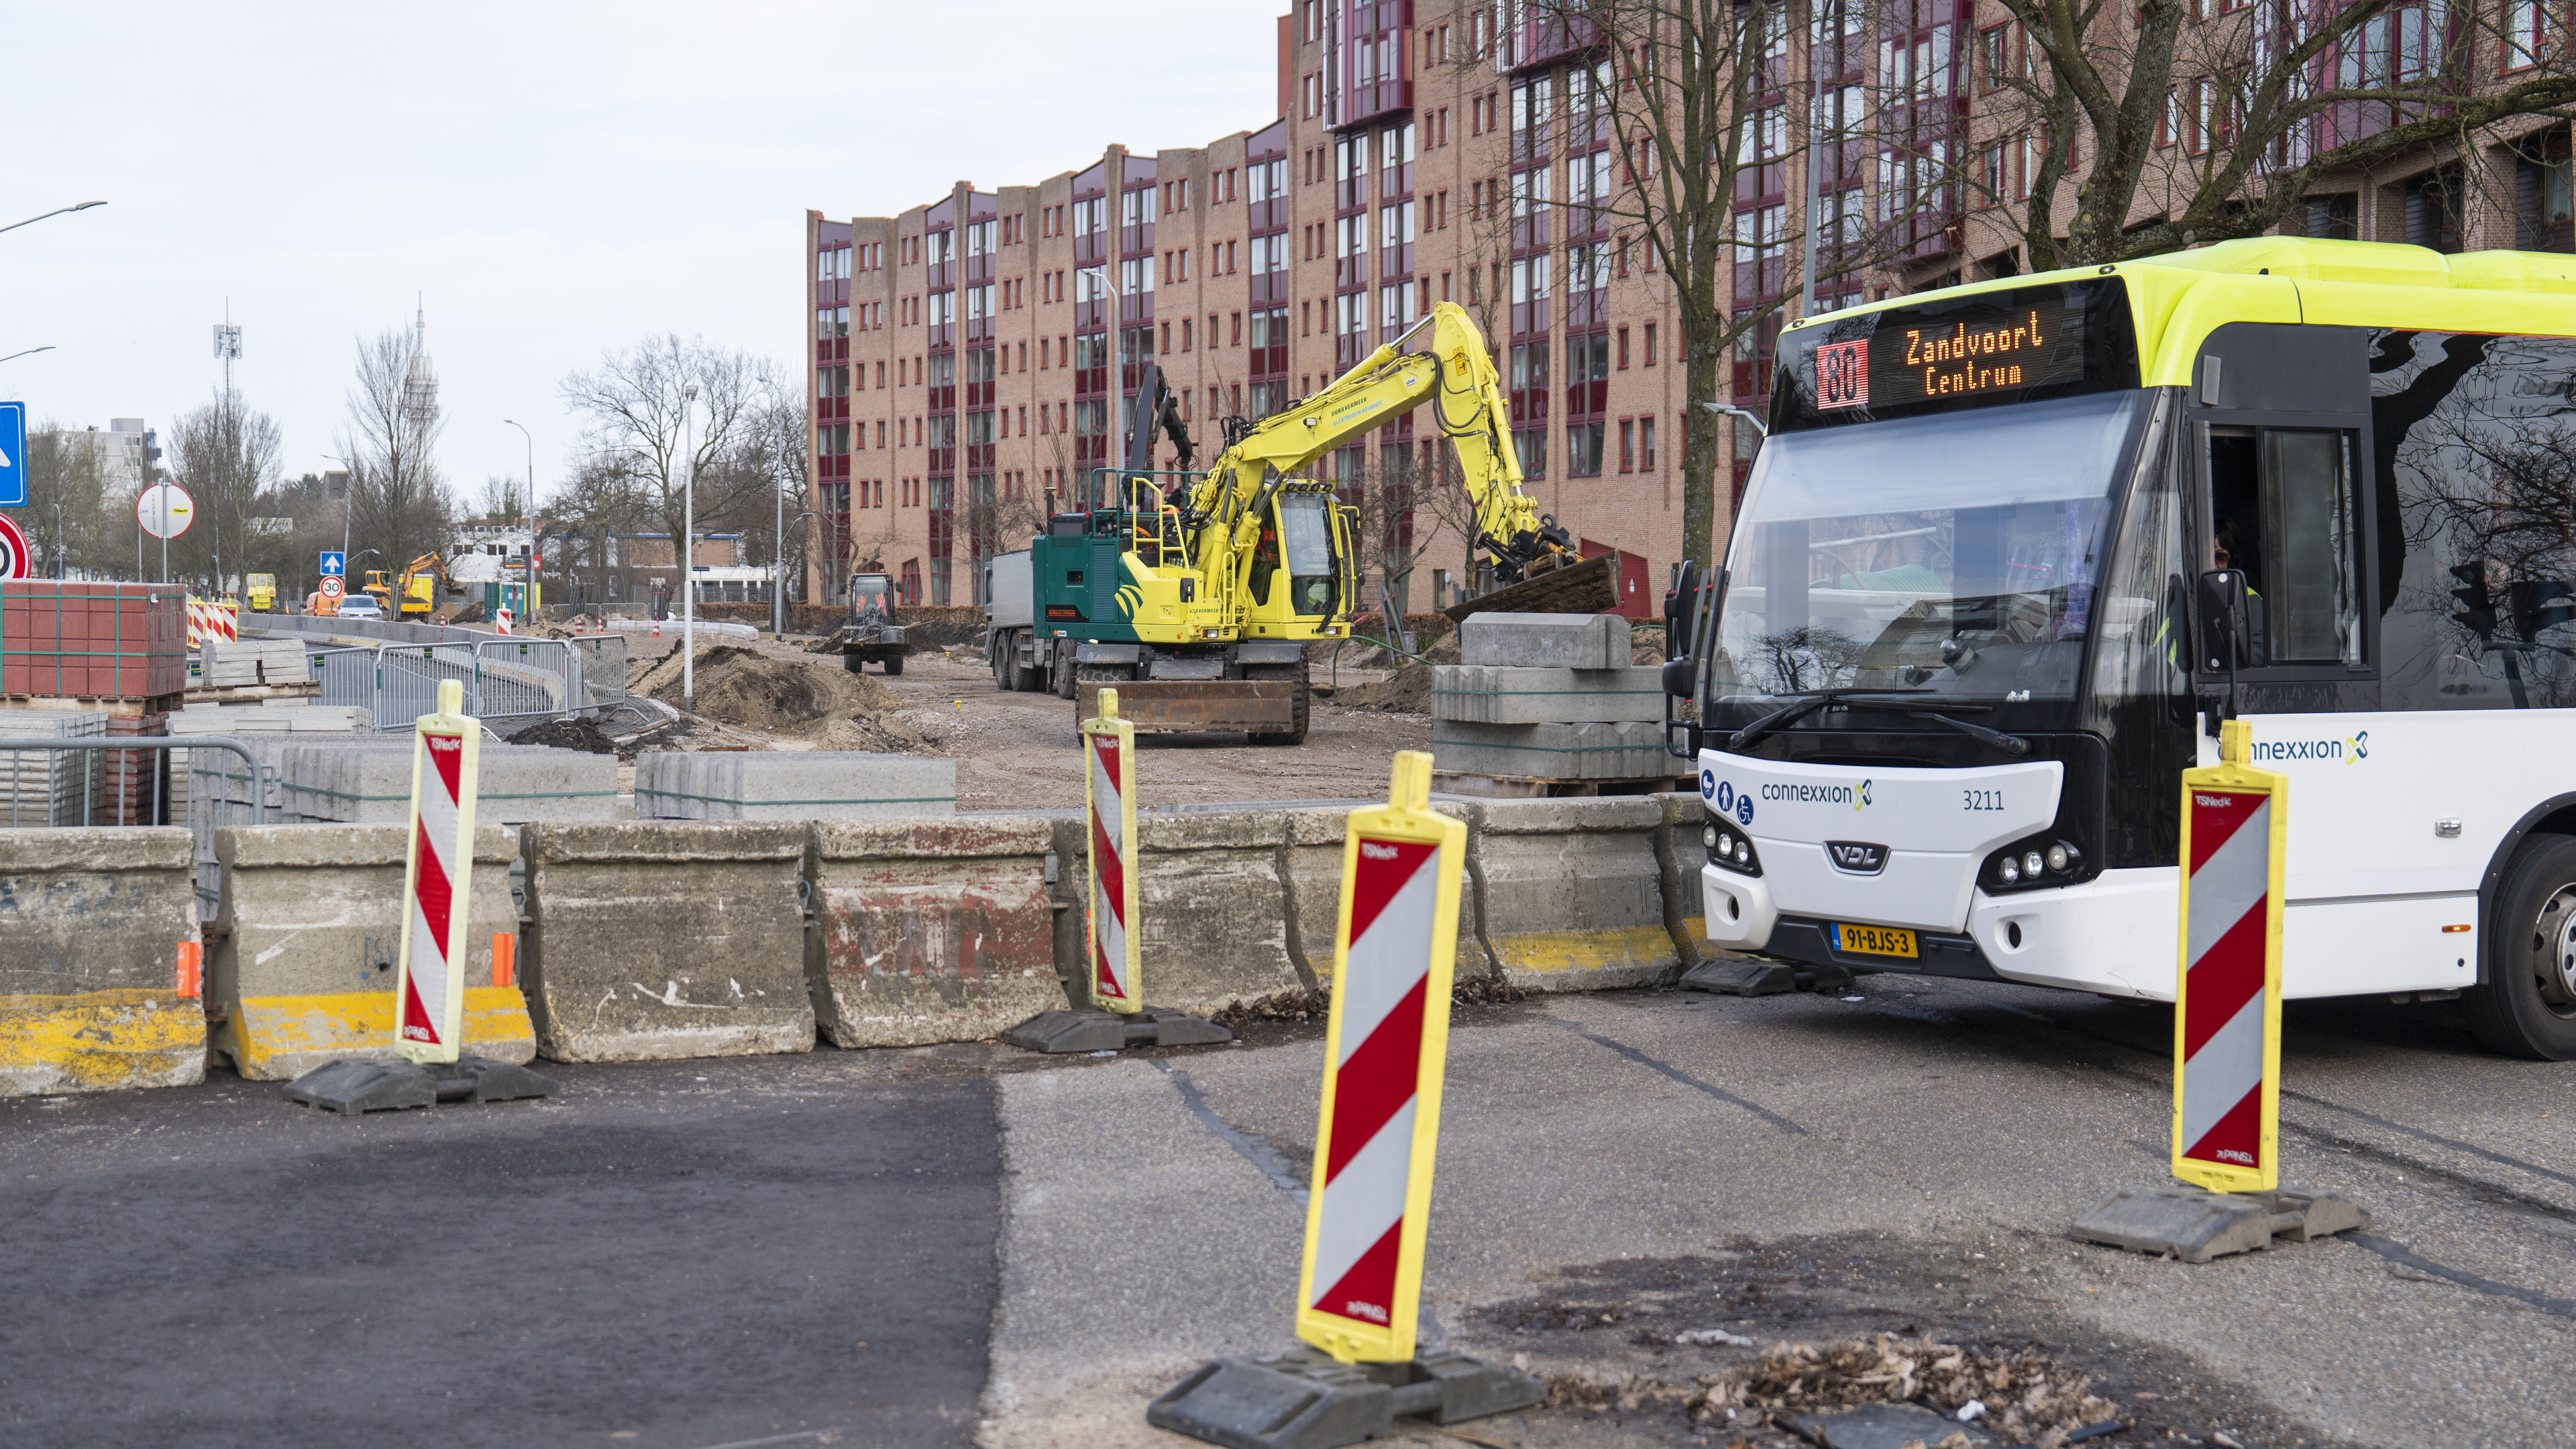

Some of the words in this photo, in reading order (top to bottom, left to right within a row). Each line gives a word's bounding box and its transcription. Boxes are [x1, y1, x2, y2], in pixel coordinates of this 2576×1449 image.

[1907, 311, 2043, 365] Zandvoort
[1826, 346, 1858, 403] 80
[1926, 360, 2021, 395] Centrum
[1333, 409, 1361, 426] ELEKTRISCH
[1361, 400, 1383, 413] VOORUIT
[325, 582, 339, 592] 30
[1762, 783, 1852, 804] connexxion
[1964, 790, 2004, 810] 3211
[1834, 846, 1878, 866] VDL
[1847, 928, 1909, 953] 91-BJS-3
